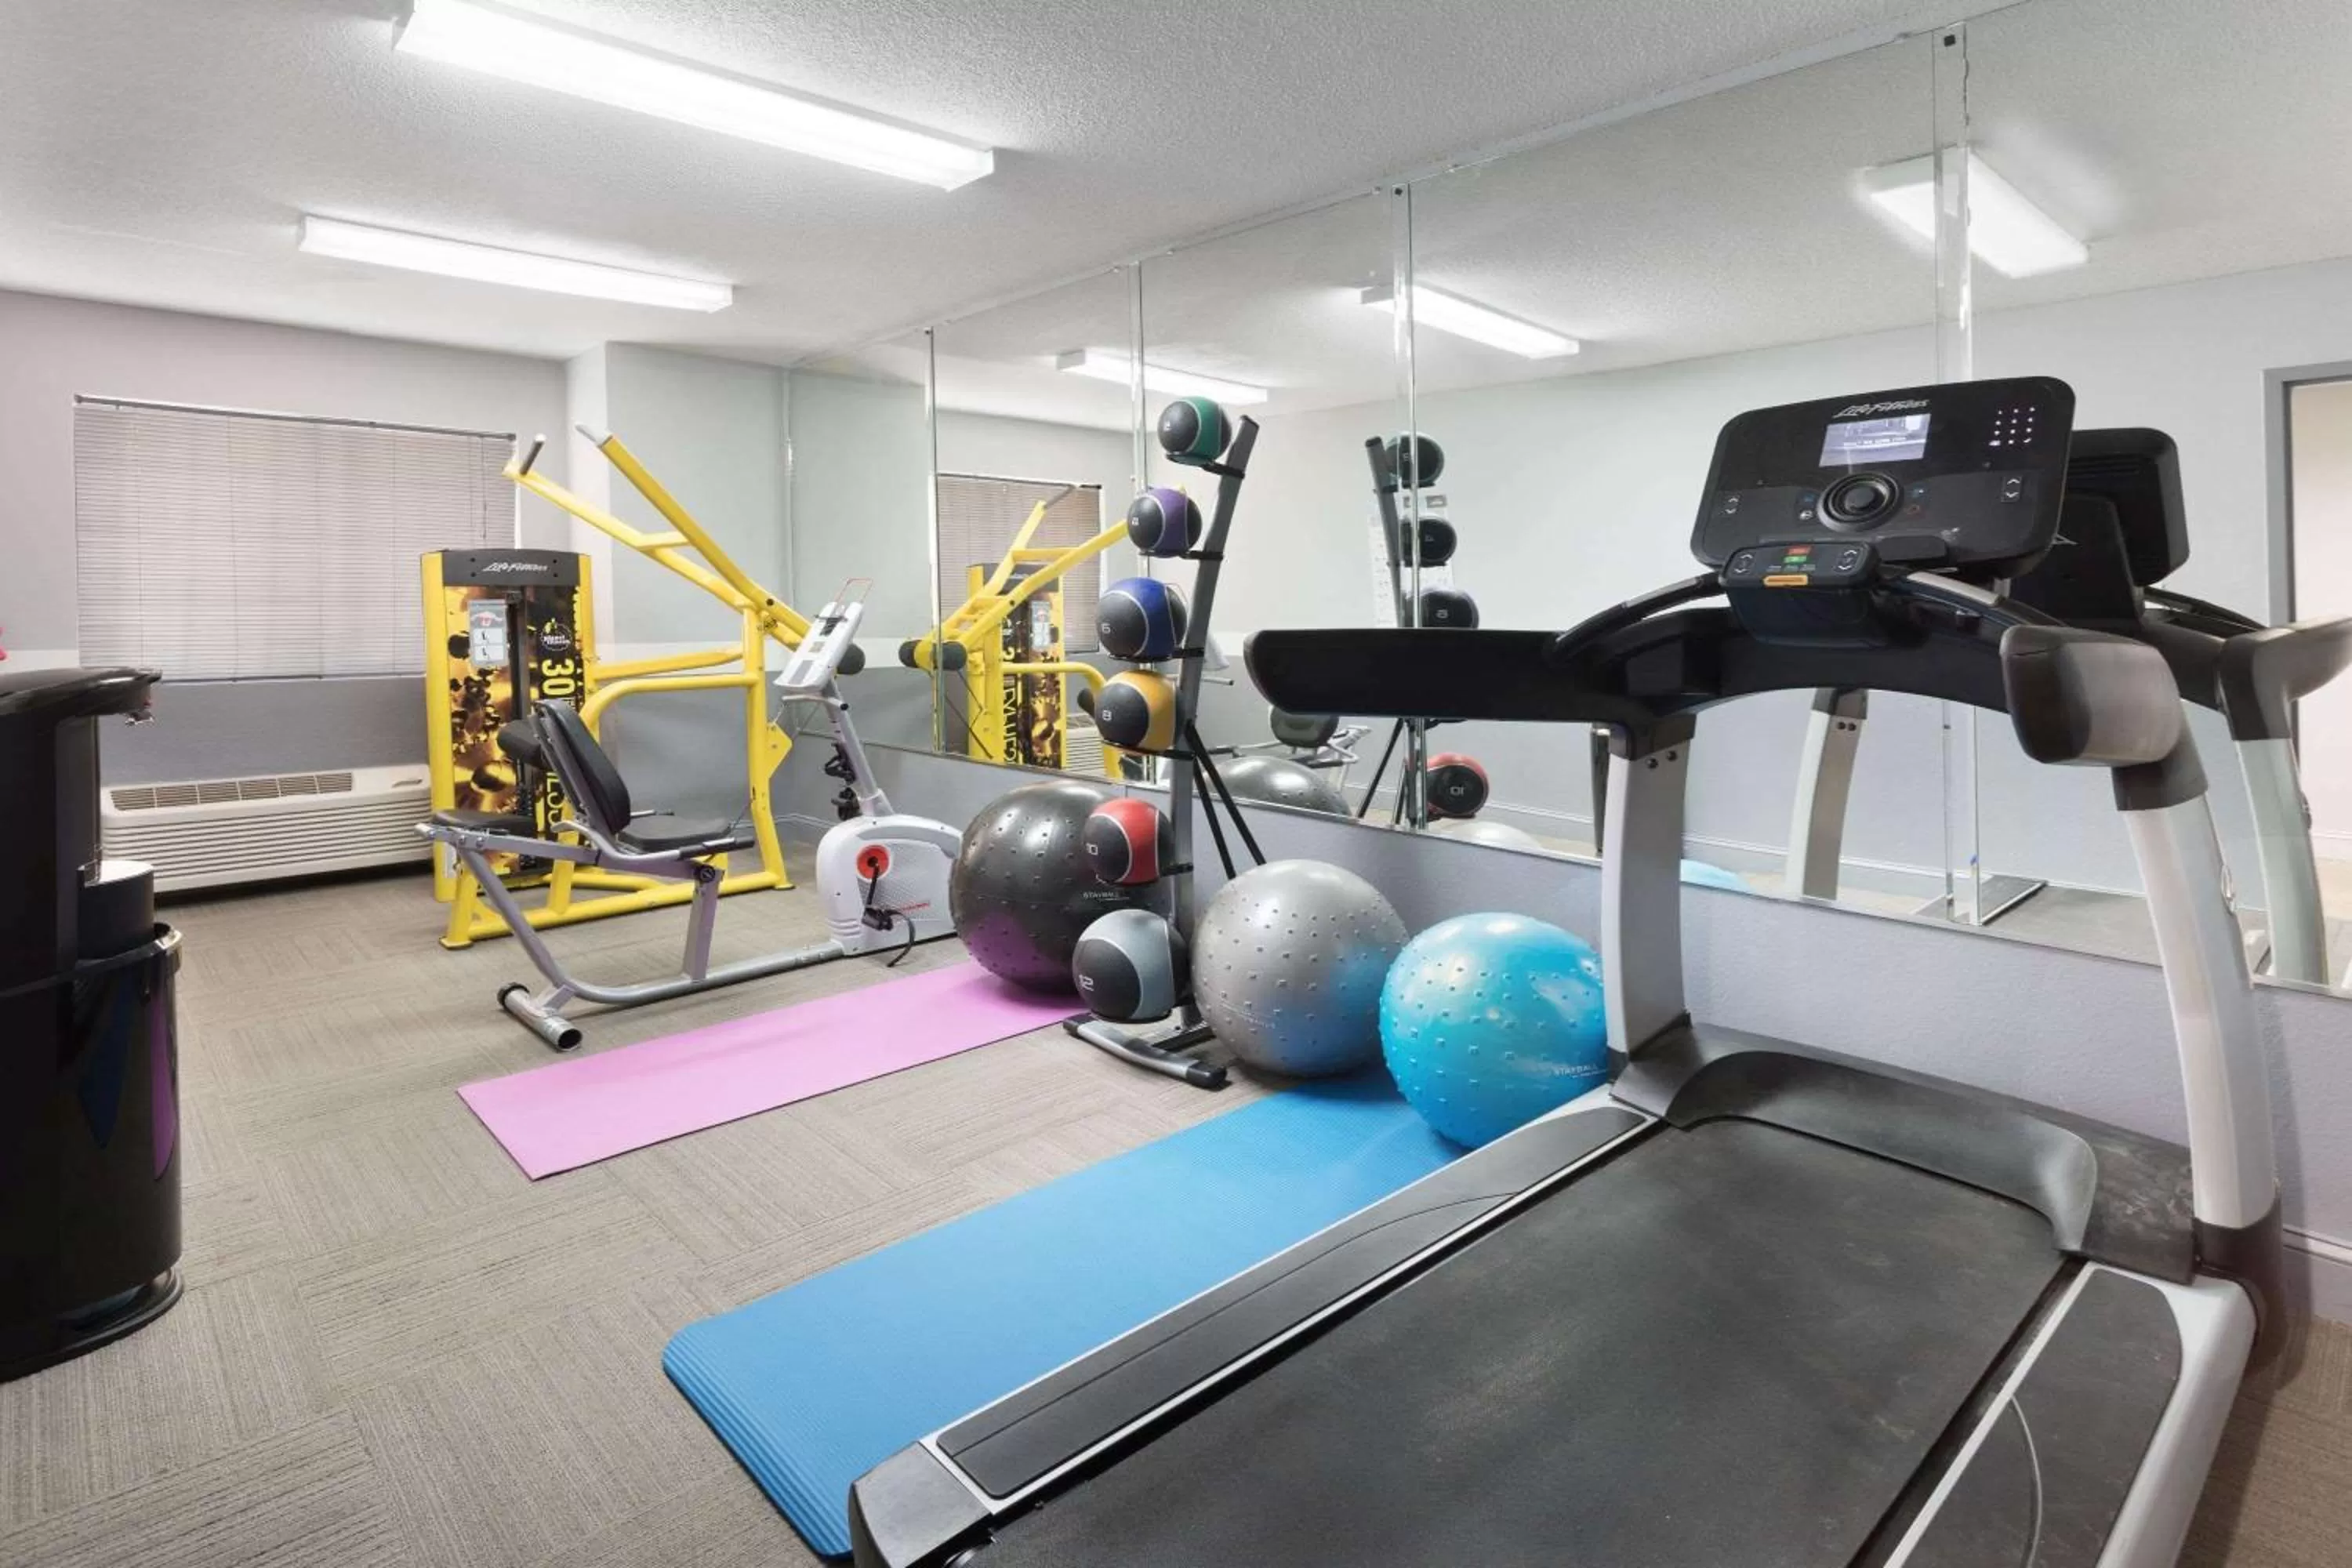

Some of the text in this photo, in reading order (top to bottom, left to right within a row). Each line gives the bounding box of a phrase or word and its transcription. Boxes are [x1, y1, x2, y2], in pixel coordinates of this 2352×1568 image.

[1100, 622, 1111, 634] 6
[542, 659, 575, 696] 30
[1101, 709, 1112, 721] 8
[1078, 974, 1094, 992] 12
